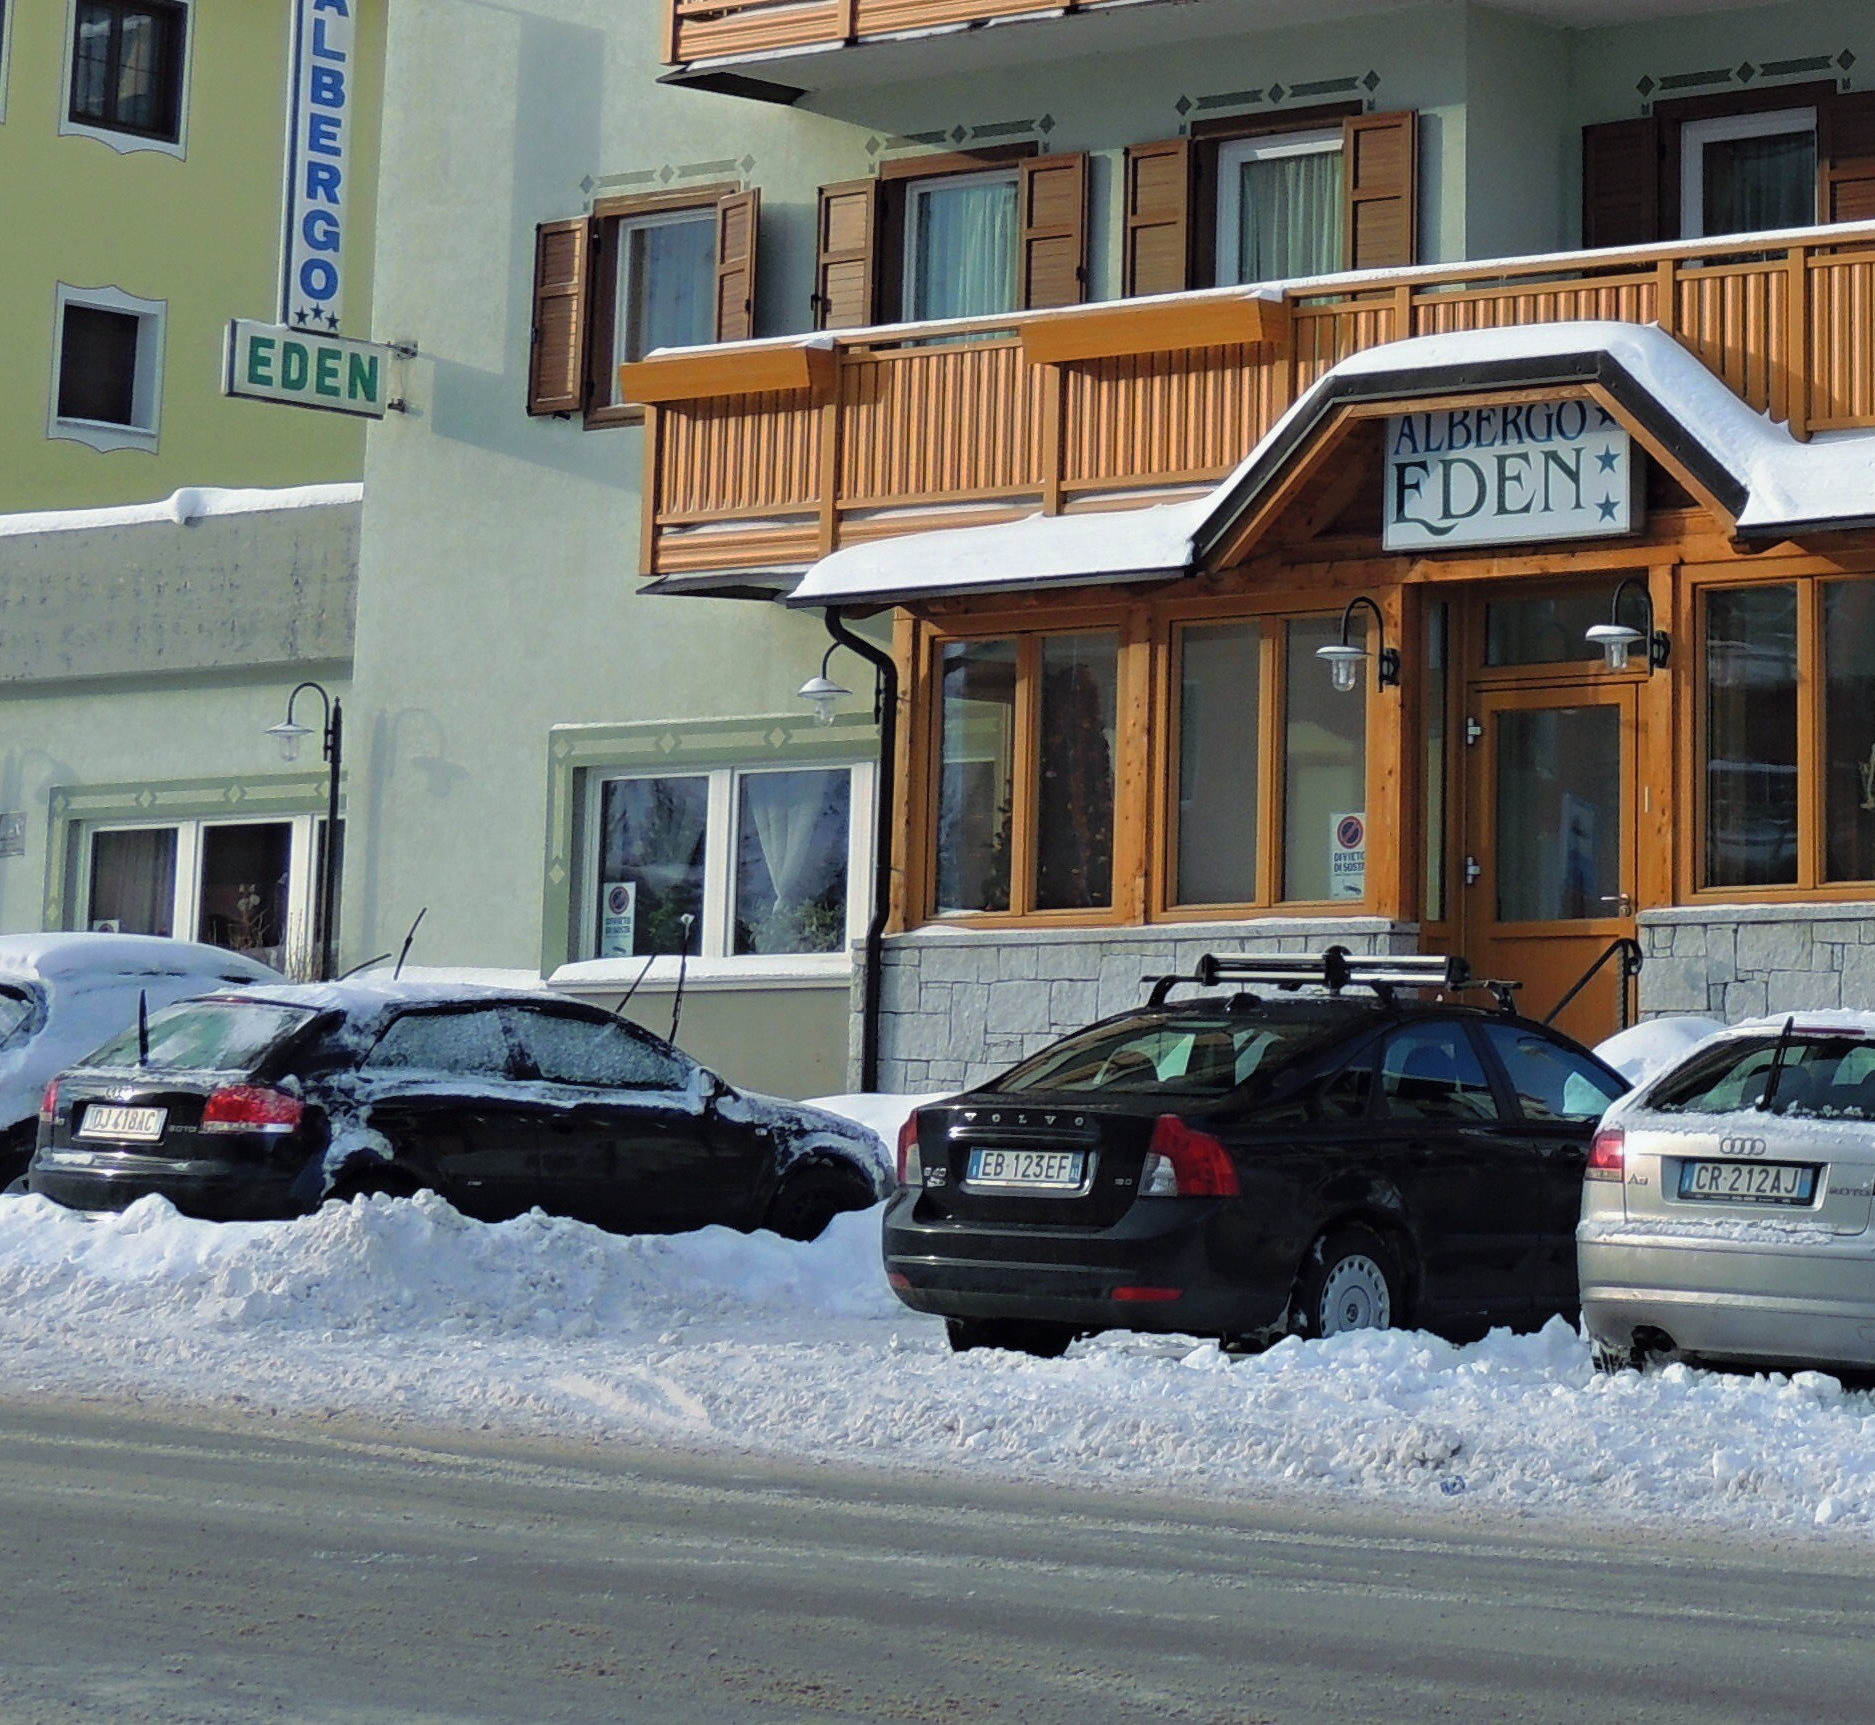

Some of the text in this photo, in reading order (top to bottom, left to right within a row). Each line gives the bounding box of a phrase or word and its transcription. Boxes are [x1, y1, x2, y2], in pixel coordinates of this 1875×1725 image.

[246, 334, 378, 403] EDEN
[1393, 400, 1587, 455] ALBERGO
[1392, 446, 1587, 537] EDEN
[964, 1112, 1084, 1126] VOLVO
[981, 1152, 1005, 1177] EB
[1013, 1154, 1070, 1179] 123EF
[1695, 1165, 1800, 1194] CR 212AJ
